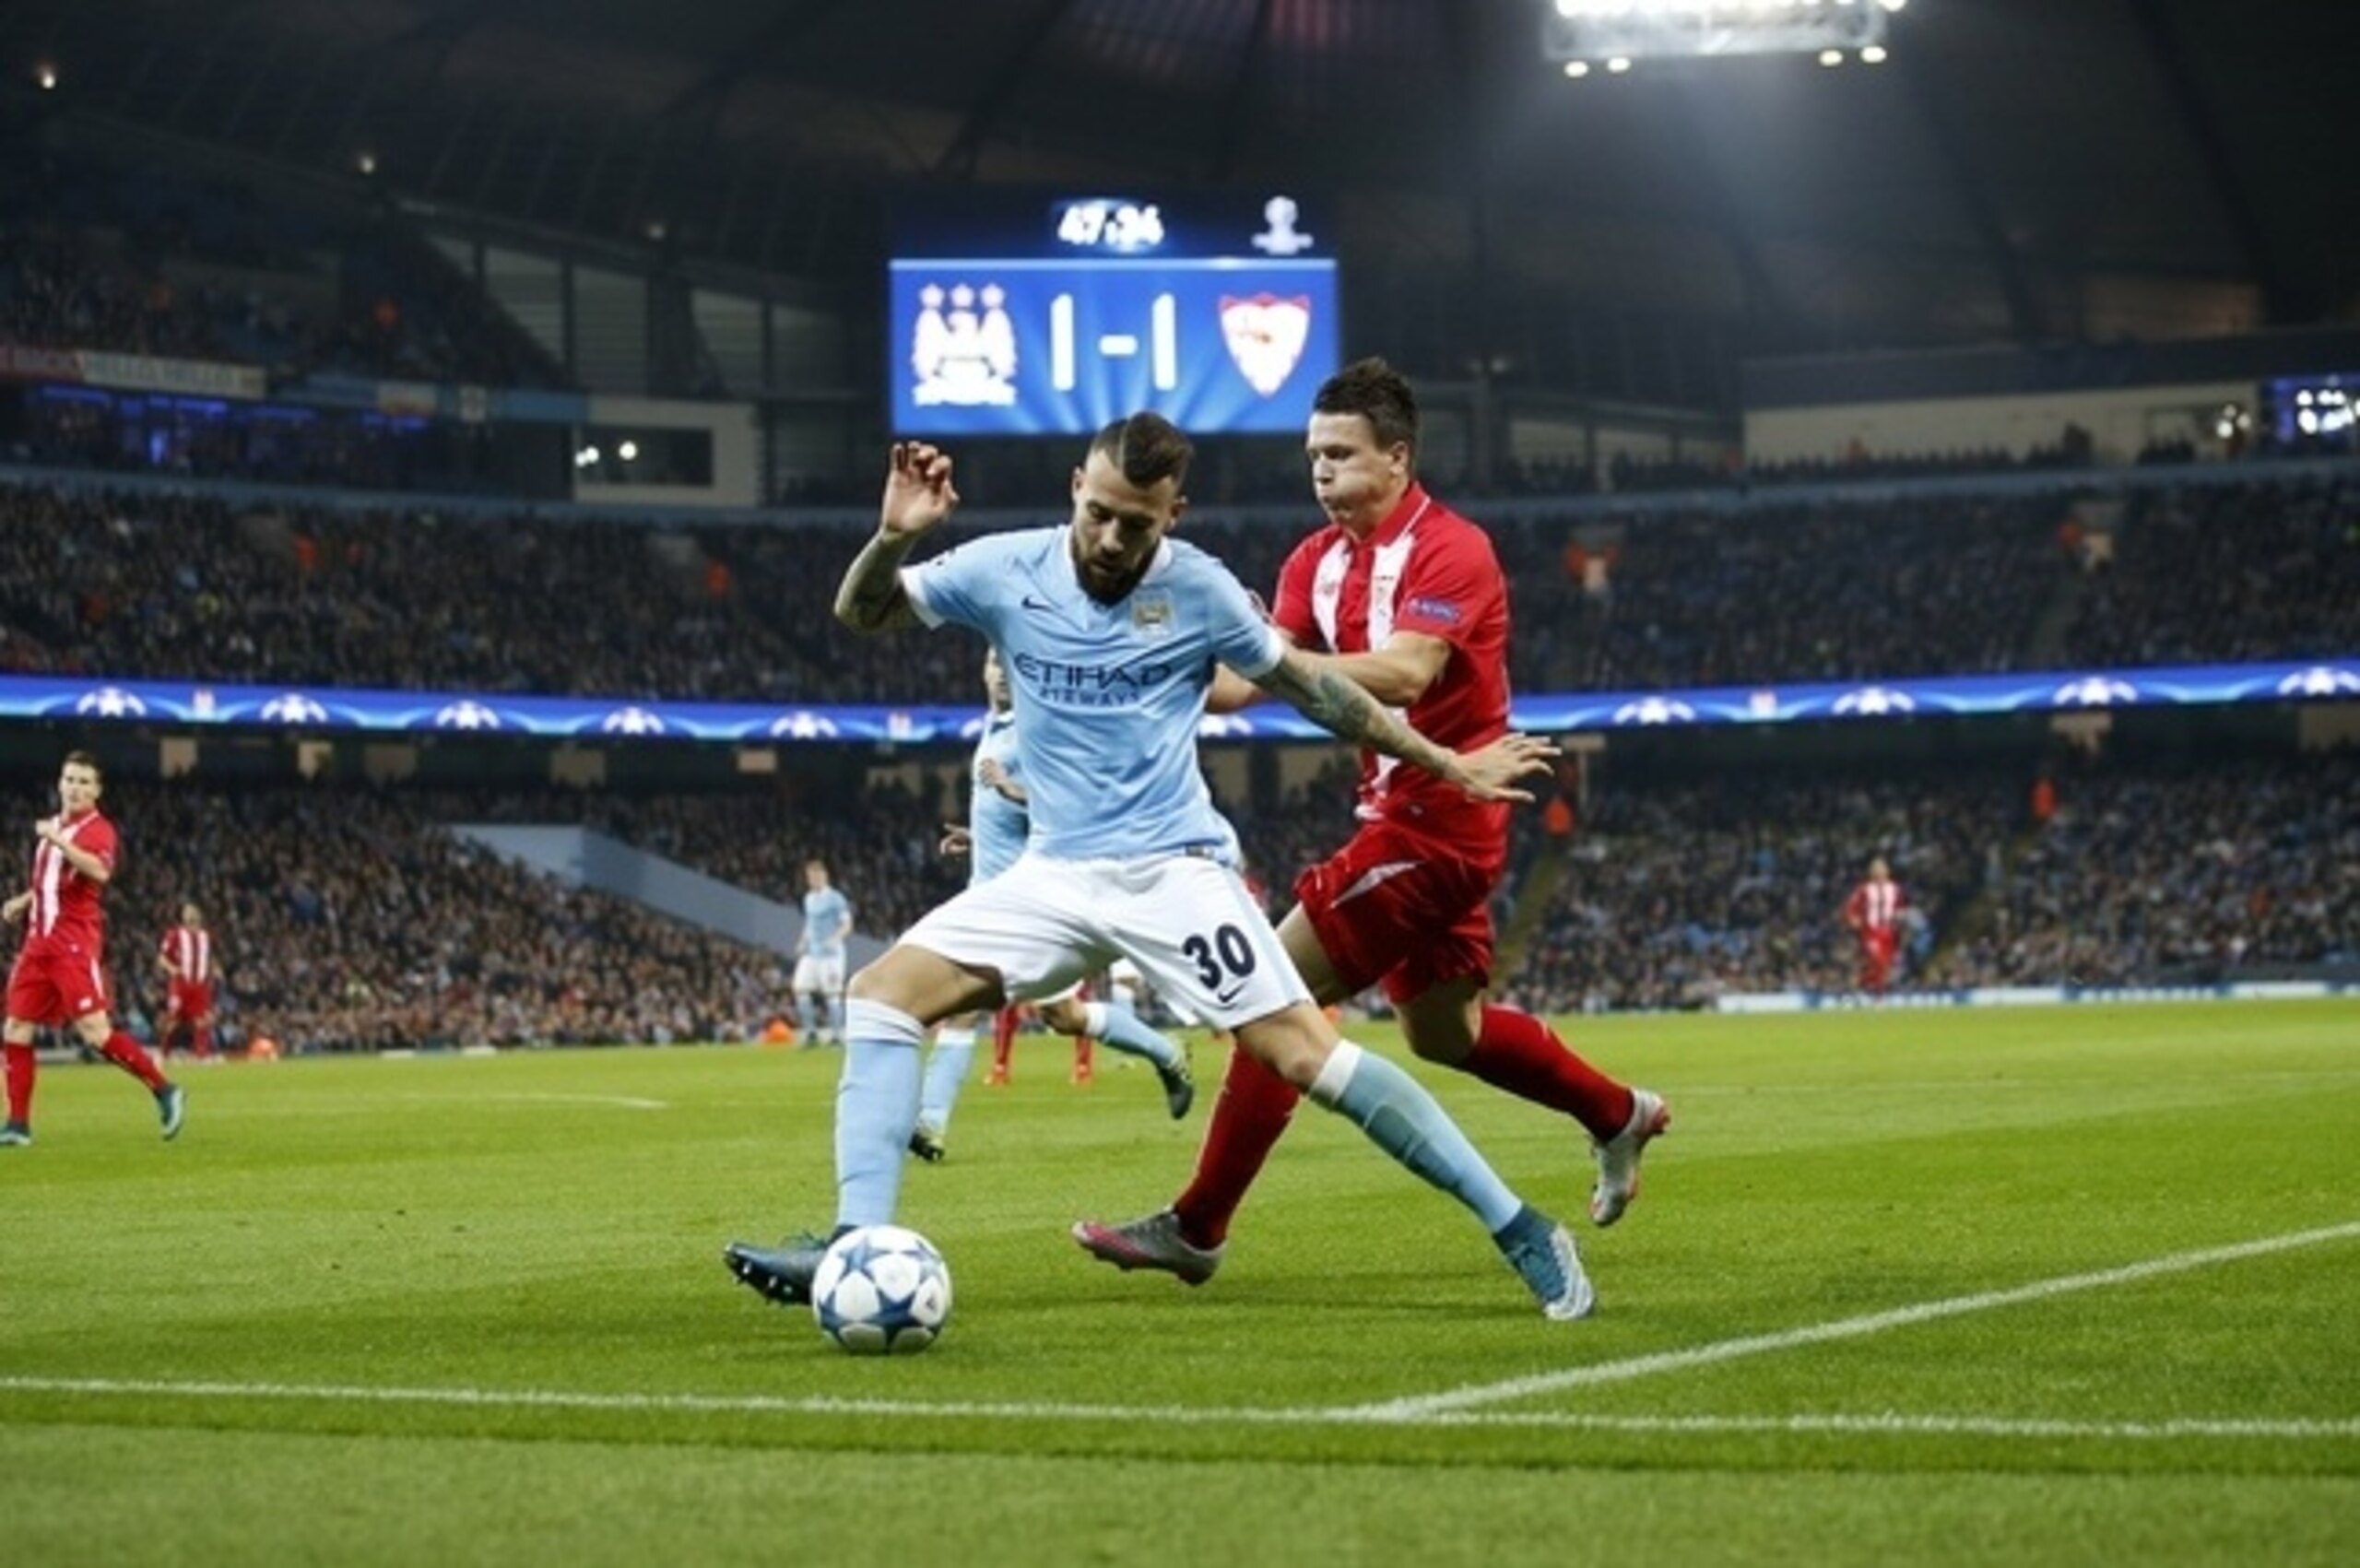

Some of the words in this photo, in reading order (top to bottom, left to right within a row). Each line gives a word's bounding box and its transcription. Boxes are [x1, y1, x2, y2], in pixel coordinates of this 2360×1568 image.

[1050, 293, 1075, 392] 1
[1151, 292, 1177, 392] 1
[1014, 653, 1172, 689] ETIHAD
[1182, 923, 1257, 990] 30
